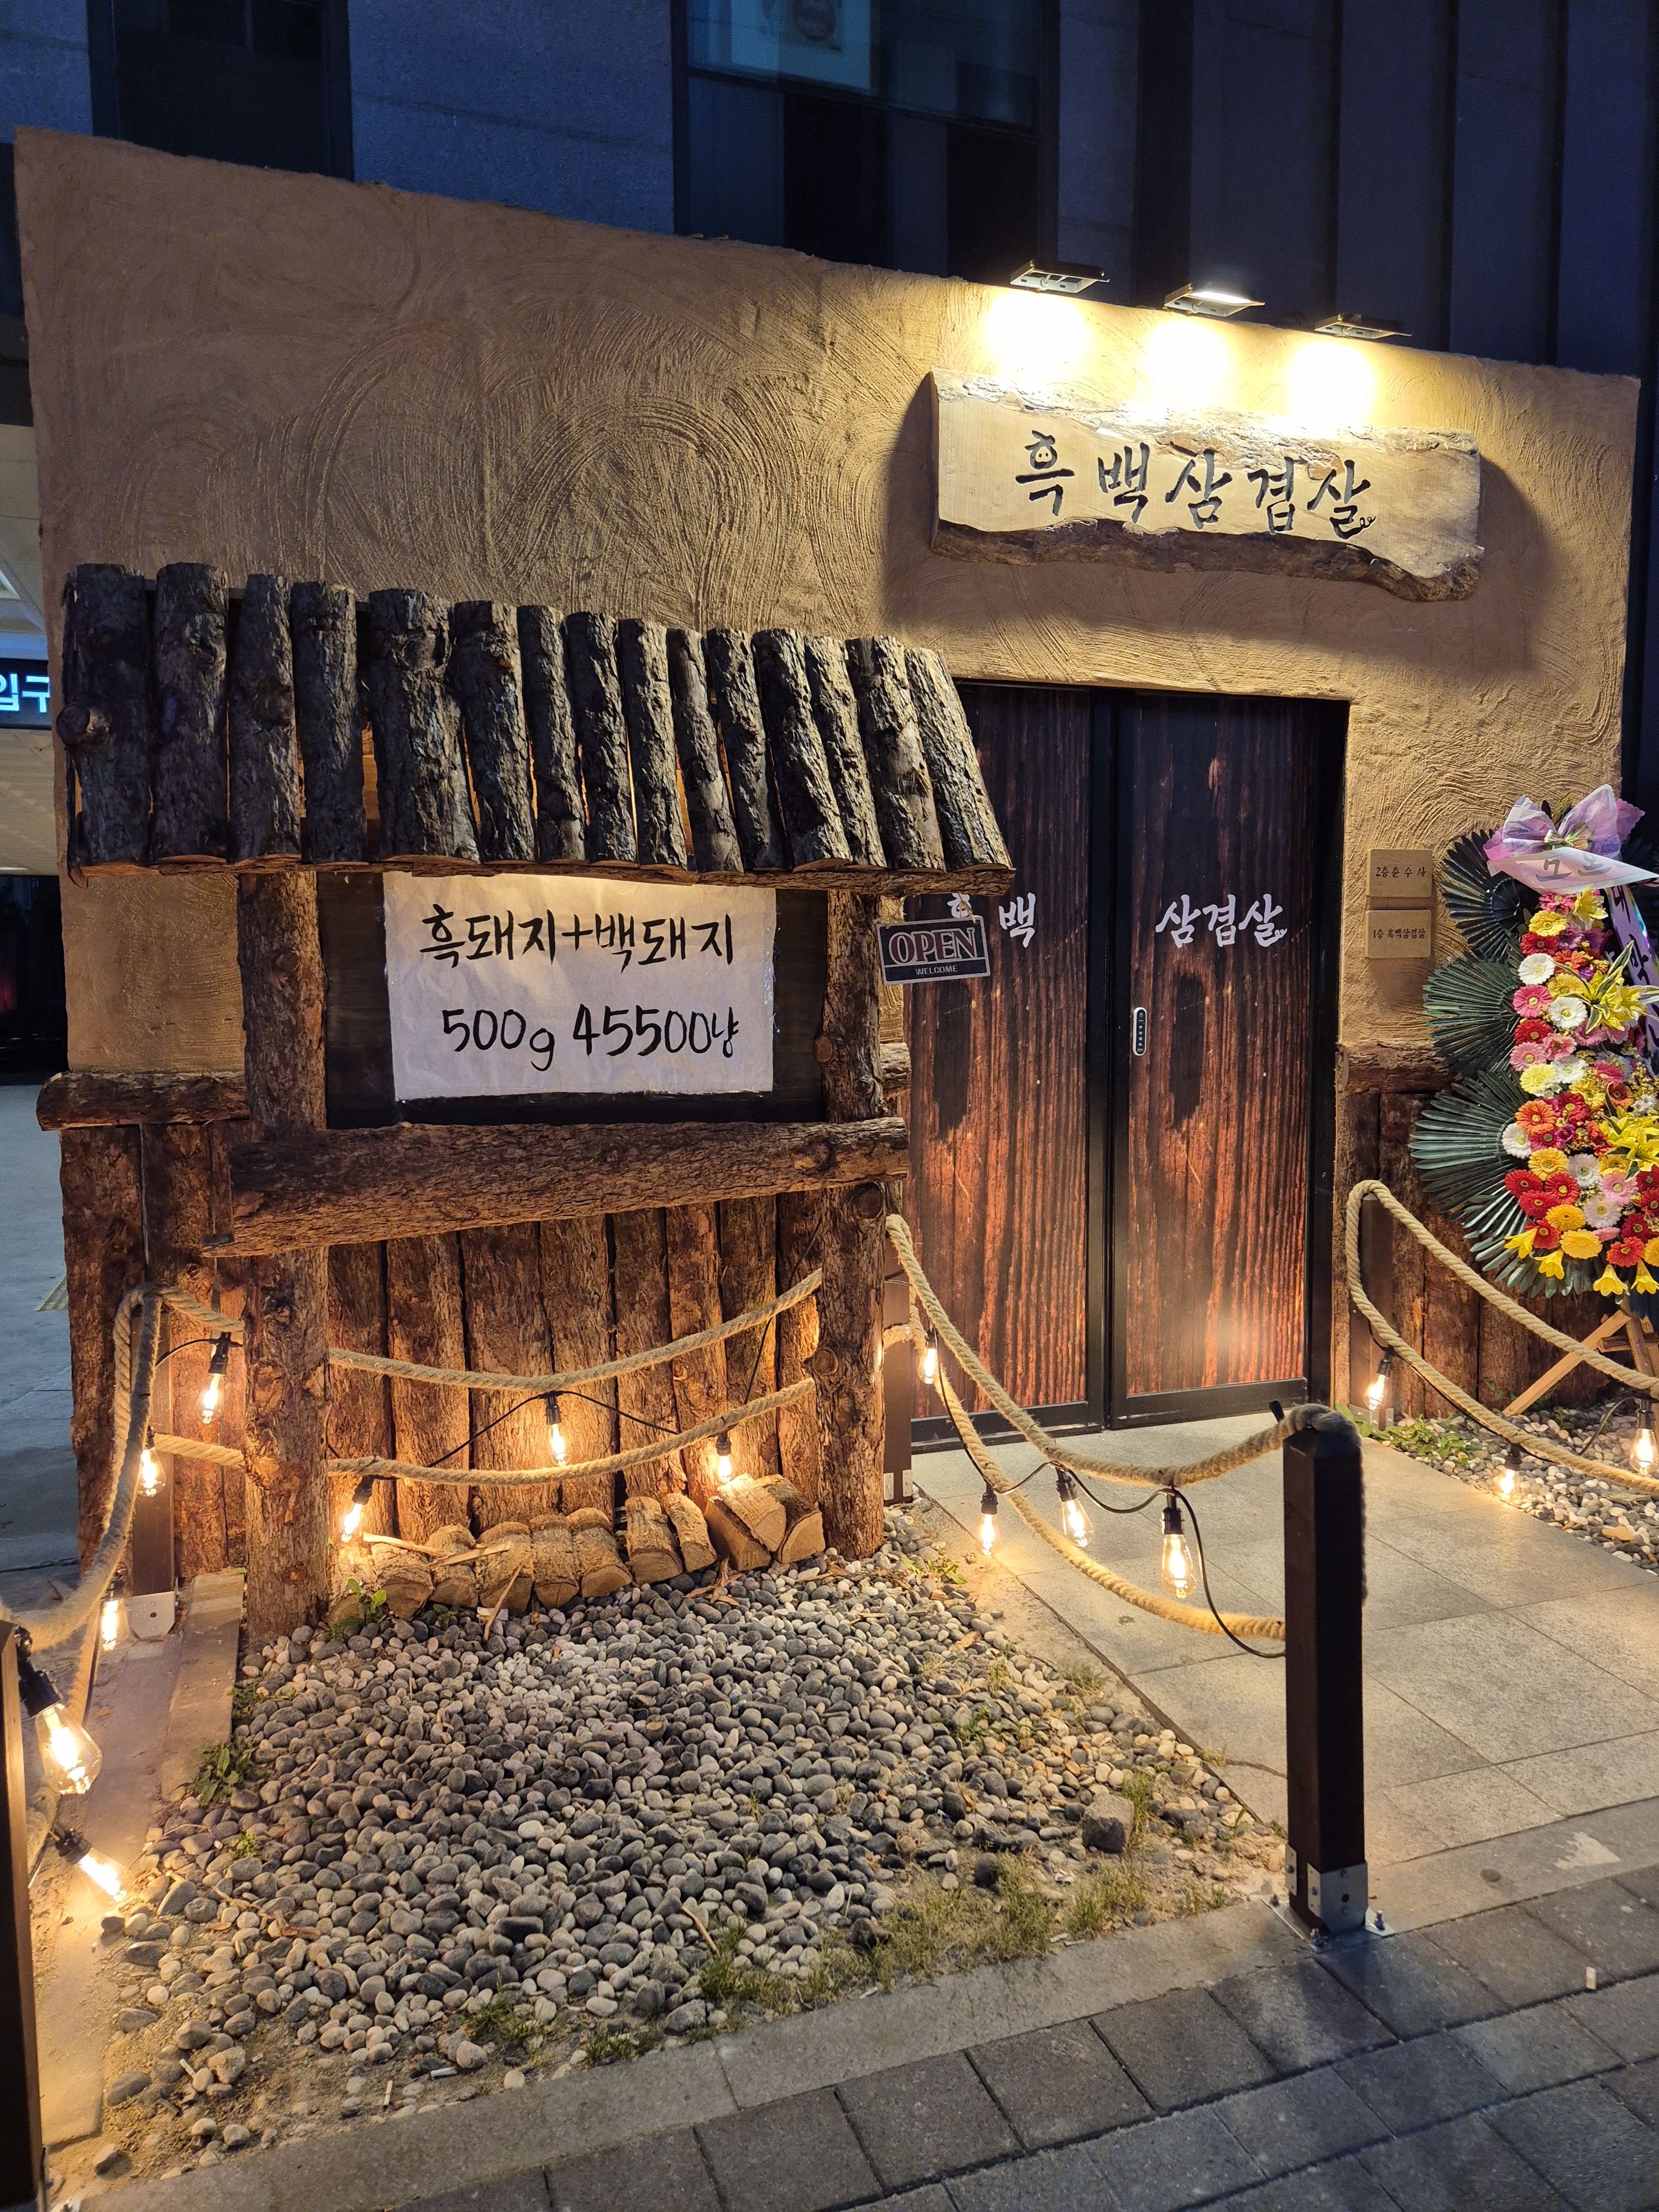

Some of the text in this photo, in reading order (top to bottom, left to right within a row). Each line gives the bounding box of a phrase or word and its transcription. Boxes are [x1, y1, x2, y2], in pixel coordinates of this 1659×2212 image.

[1016, 430, 1376, 540] 흑백삼겹살
[1375, 866, 1389, 878] 2층
[419, 903, 733, 973] 흑돼지+백돼지
[1156, 894, 1287, 948] 삼겹살
[1373, 928, 1385, 940] 1층
[889, 927, 975, 964] OPEN
[915, 965, 958, 975] WELCOME
[442, 1004, 739, 1071] 500g 45500냥
